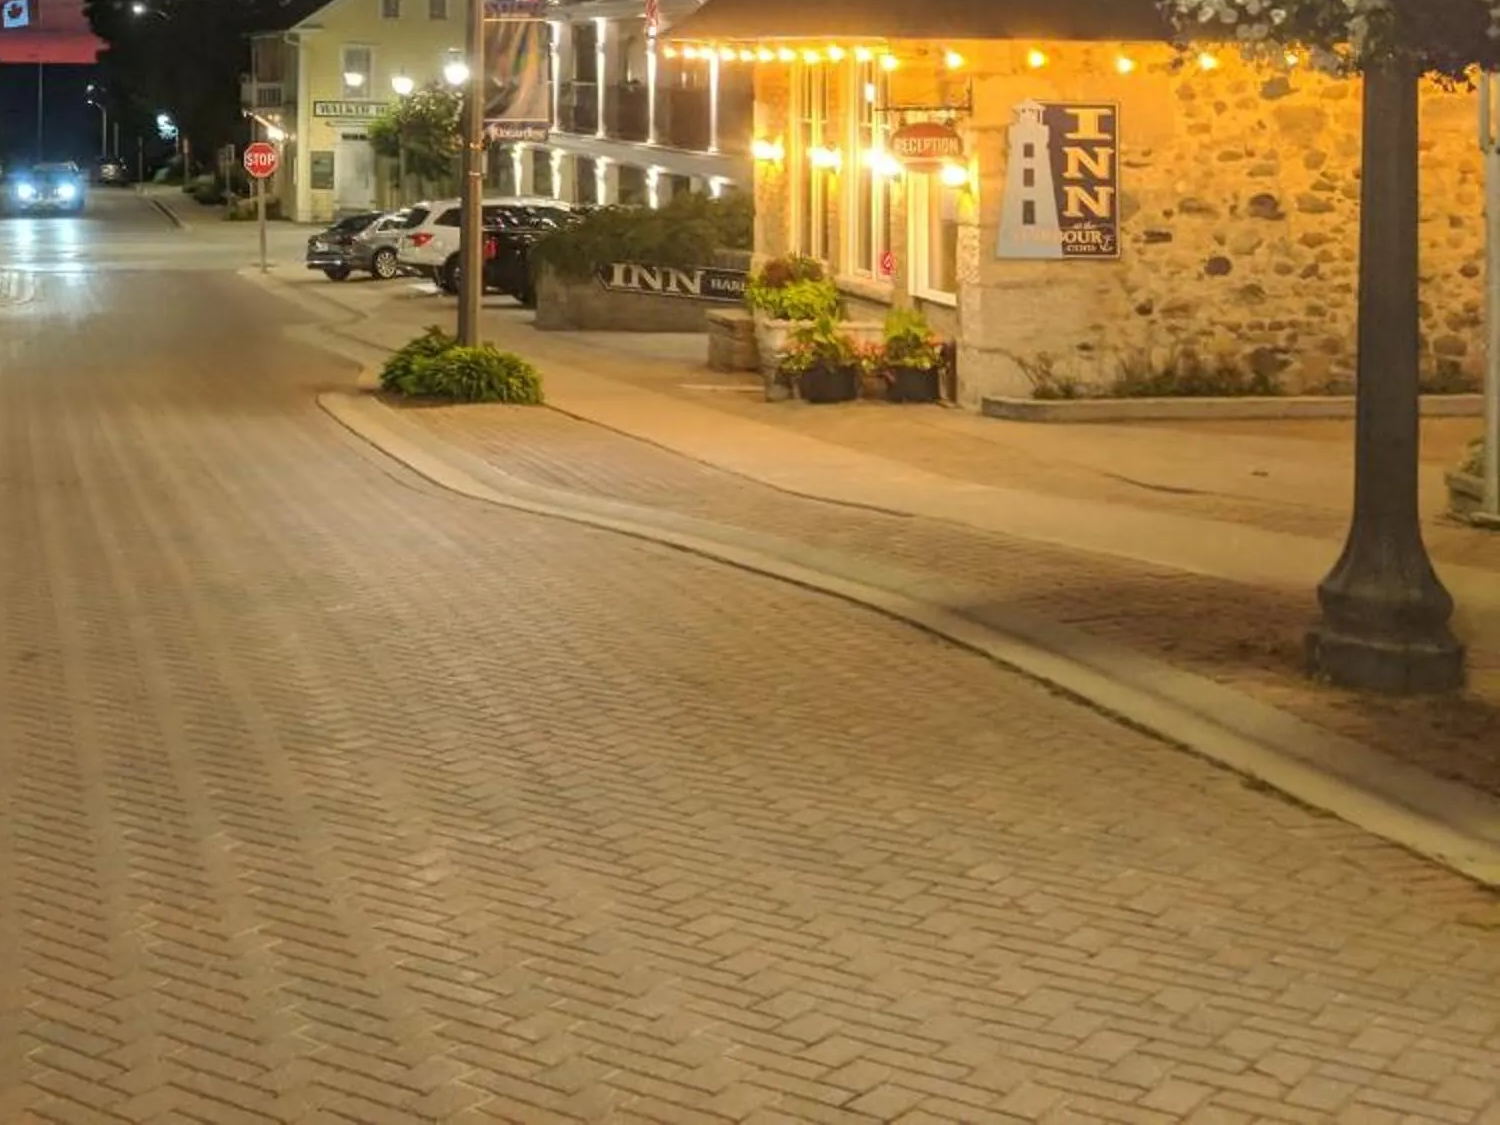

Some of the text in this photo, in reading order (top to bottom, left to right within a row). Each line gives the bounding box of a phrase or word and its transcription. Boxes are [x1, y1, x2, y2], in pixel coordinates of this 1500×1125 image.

[894, 138, 959, 154] RECEPTION
[246, 153, 275, 166] STOP
[1061, 107, 1115, 218] INN
[610, 263, 706, 294] INN
